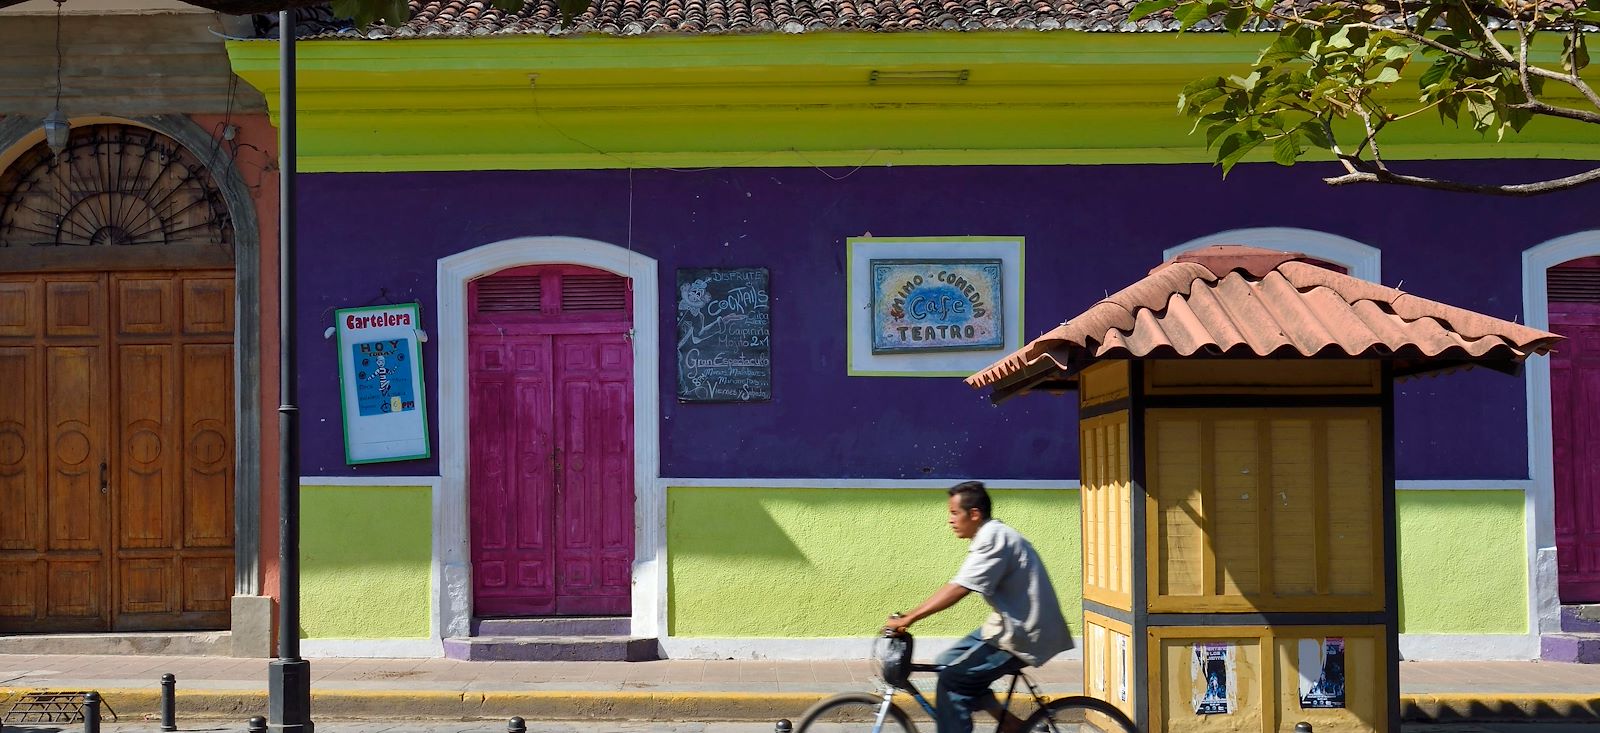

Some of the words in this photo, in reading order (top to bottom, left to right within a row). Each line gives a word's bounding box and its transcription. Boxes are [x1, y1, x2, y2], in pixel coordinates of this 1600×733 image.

[711, 271, 761, 282] DISFRUTE
[708, 286, 769, 316] COCKTAILS
[891, 275, 923, 313] MIMO
[938, 270, 986, 319] COMEDIA
[911, 295, 965, 320] Cafe
[347, 312, 410, 329] Cartelera
[896, 324, 975, 342] TEATRO
[360, 340, 399, 353] HOY
[685, 348, 713, 379] Gran
